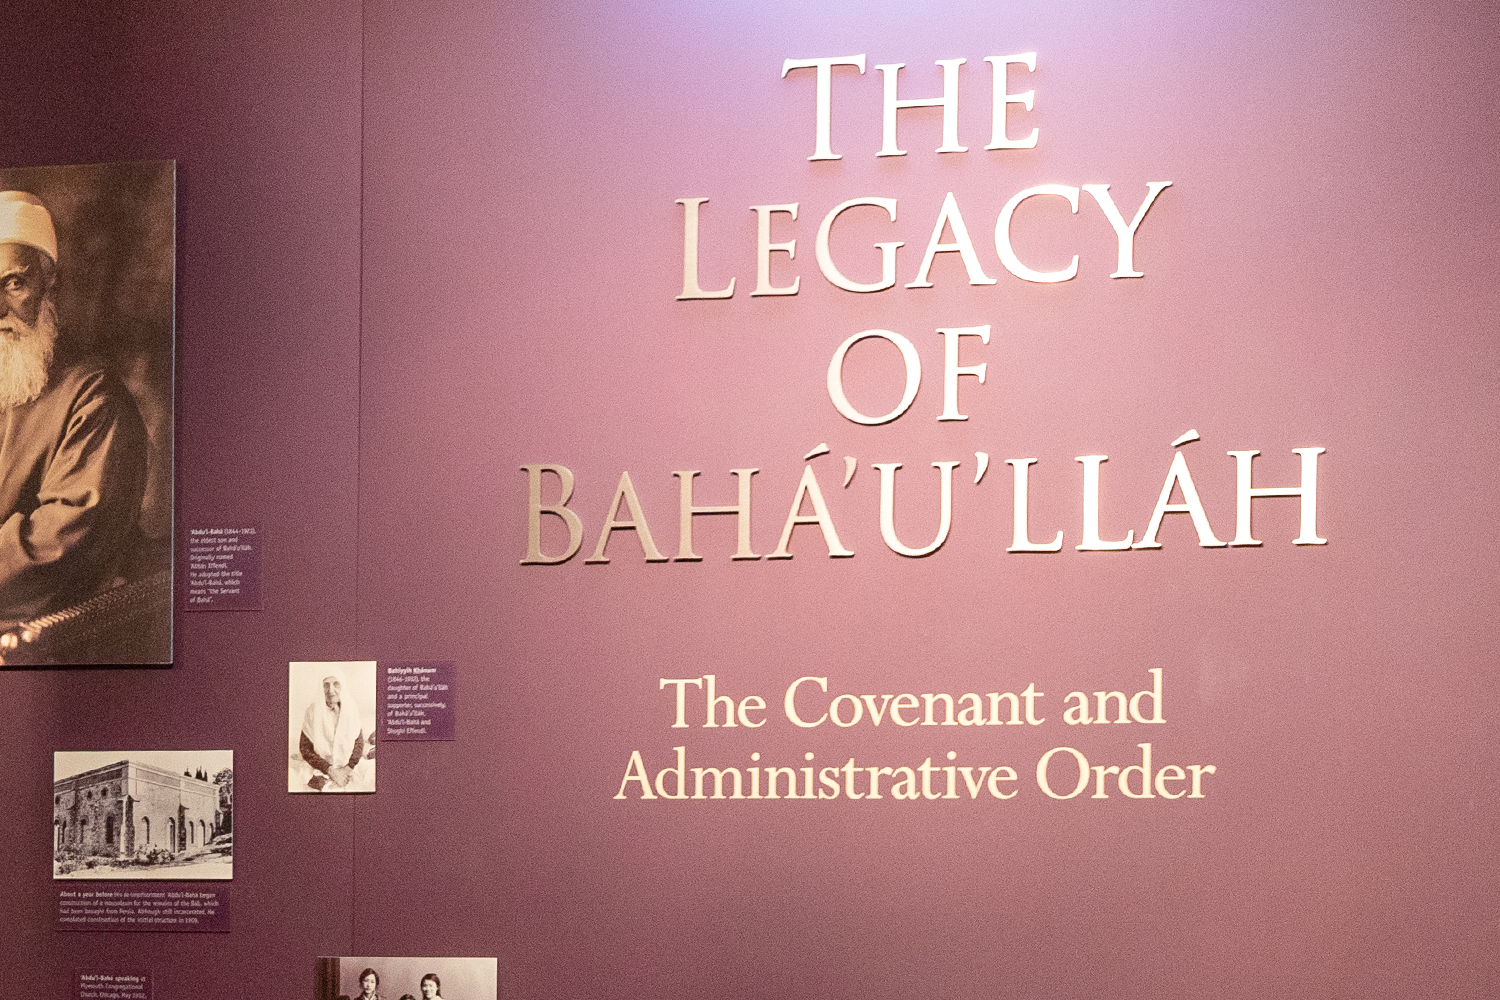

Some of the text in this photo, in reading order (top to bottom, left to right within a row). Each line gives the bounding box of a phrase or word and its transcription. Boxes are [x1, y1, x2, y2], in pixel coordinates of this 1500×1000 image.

[782, 51, 1040, 162] THE
[674, 181, 1173, 301] LEGACY
[827, 324, 991, 425] OF
[520, 428, 1327, 566] BAHÁ'U'LLÁH
[659, 668, 1167, 729] The Covenant and
[612, 743, 1216, 801] Administrative Order
